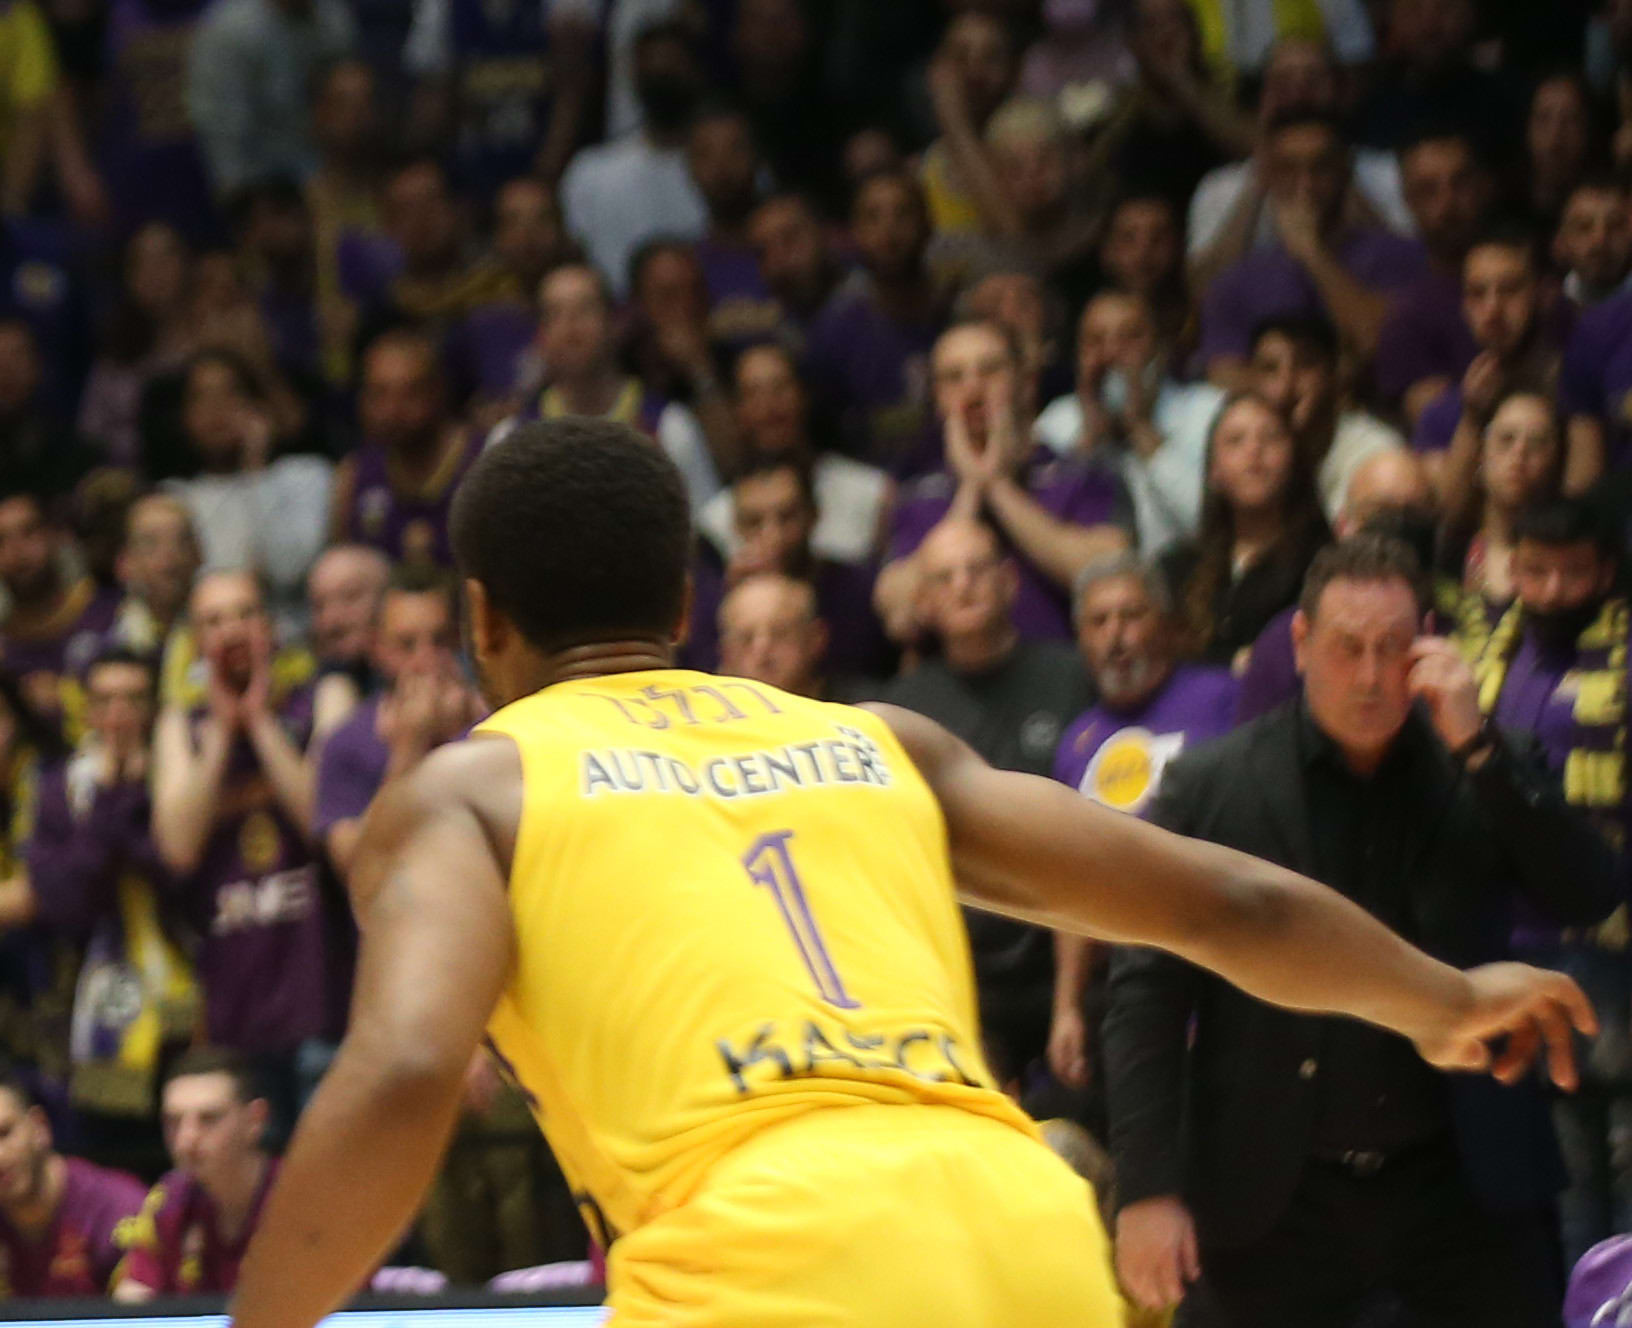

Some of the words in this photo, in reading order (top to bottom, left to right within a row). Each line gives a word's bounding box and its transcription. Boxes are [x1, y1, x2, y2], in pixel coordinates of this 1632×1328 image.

[582, 750, 700, 797] AUTO
[708, 737, 890, 799] CENTER
[742, 828, 860, 1010] 1
